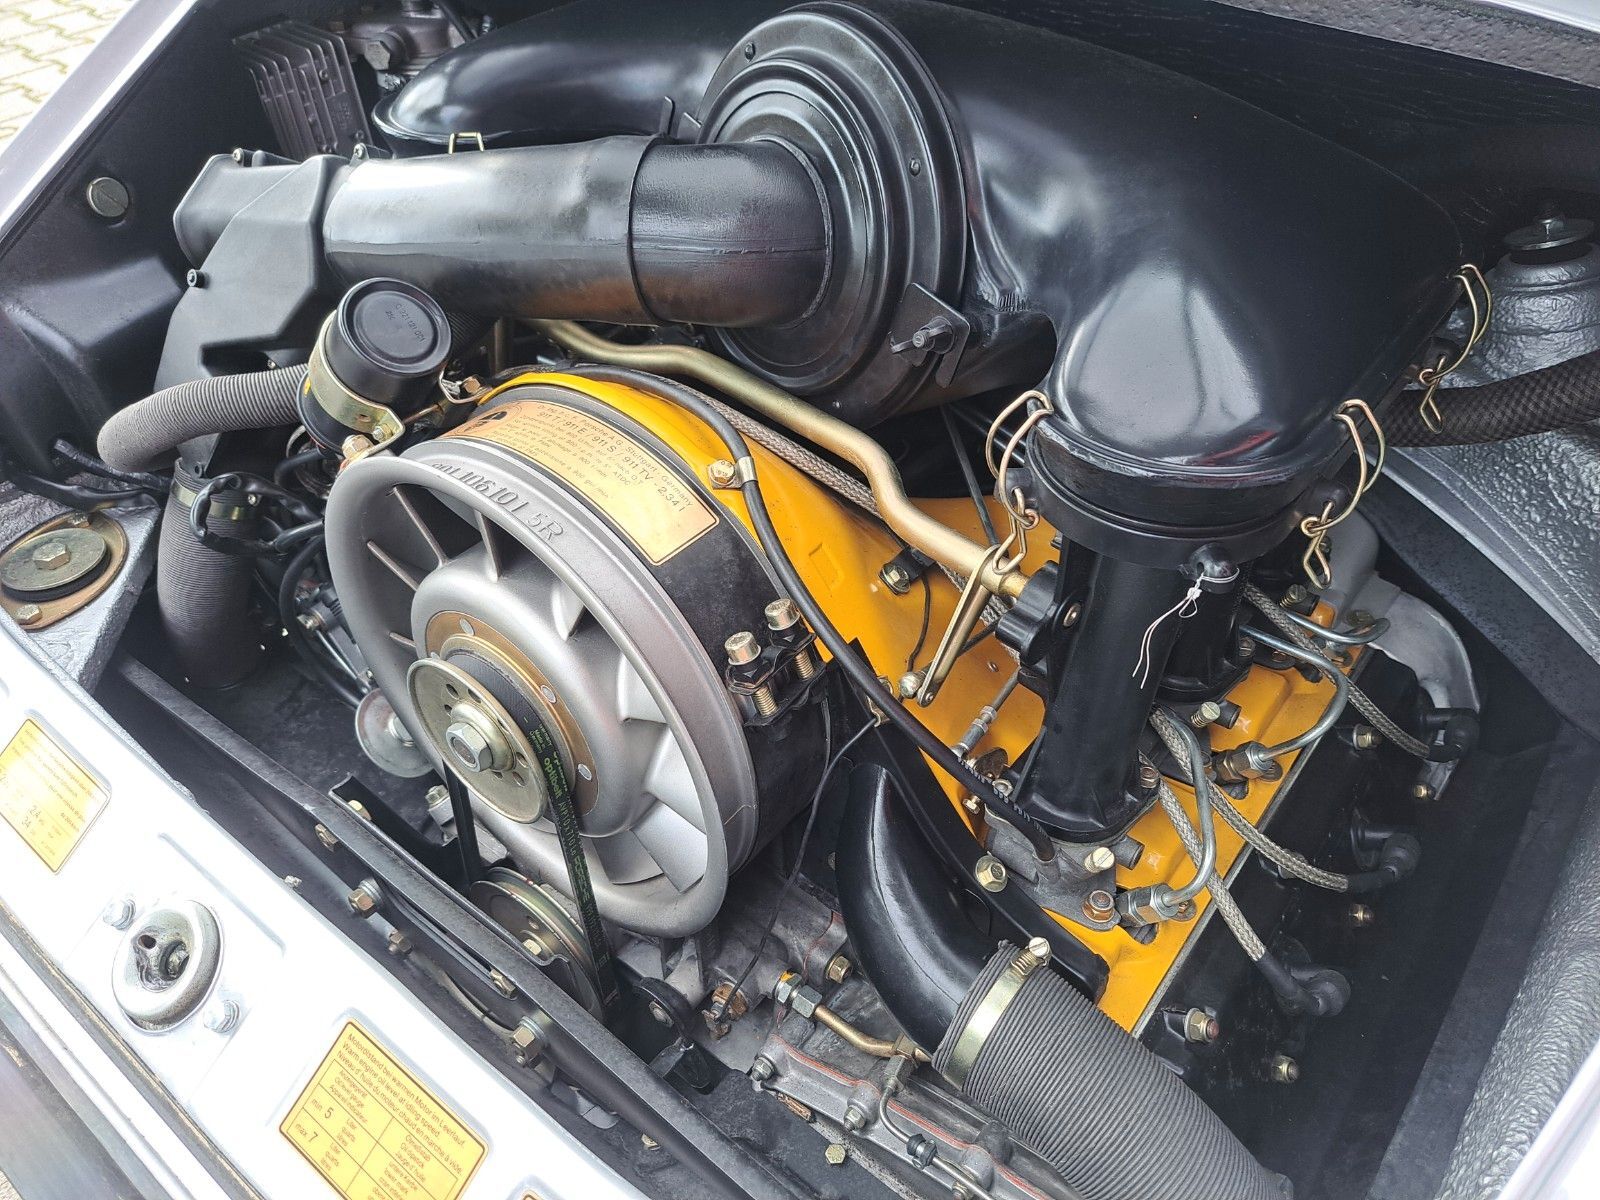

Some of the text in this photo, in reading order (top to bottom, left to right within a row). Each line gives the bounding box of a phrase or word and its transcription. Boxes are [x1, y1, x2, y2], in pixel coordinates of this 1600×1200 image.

[563, 421, 579, 430] 911
[592, 436, 608, 447] 911
[606, 445, 617, 453] S
[623, 456, 639, 469] 911
[639, 469, 654, 480] TV
[657, 486, 680, 506] 2,34
[580, 418, 609, 436] Porsche
[626, 446, 657, 472] Stuttgart
[662, 475, 693, 506] Germany
[543, 756, 561, 799] optibelt
[310, 1098, 335, 1120] min 5
[336, 1050, 357, 1071] Niveau
[379, 1091, 401, 1113] moteur
[398, 1109, 418, 1129] chaud
[423, 1132, 447, 1157] marche
[341, 1042, 360, 1062] Warm
[357, 1057, 379, 1080] engine
[377, 1075, 387, 1087] oil
[384, 1082, 400, 1100] level
[403, 1100, 422, 1122] idling
[382, 1066, 393, 1079] bei
[413, 1096, 433, 1116] Motor
[431, 1112, 441, 1124] im
[294, 1123, 318, 1144] max 7
